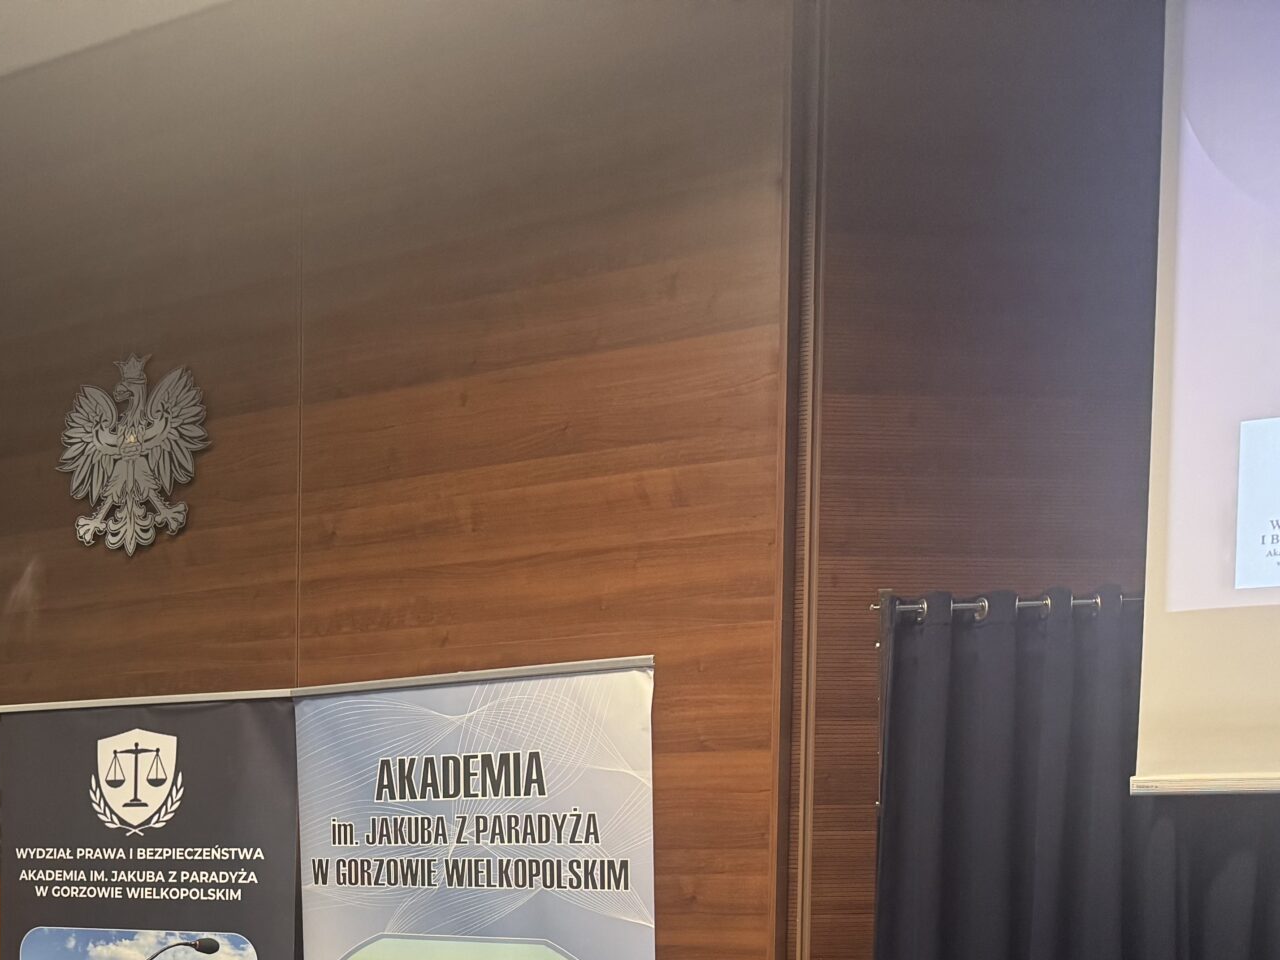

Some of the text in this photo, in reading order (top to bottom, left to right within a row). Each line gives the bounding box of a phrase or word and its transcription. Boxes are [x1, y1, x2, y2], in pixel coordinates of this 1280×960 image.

[375, 750, 547, 801] AKADEMIA
[331, 807, 601, 846] im. JAKUBA Z PARADYŻA
[15, 844, 265, 861] WYDZIAŁ PRAWA I BEZPIECZEŃSTWA
[19, 867, 259, 885] AKADEMIA IM. JAKUBA Z PARADYŻA
[311, 857, 631, 891] W GORZOWIE WIELKOPOLSKIM
[35, 886, 242, 901] W GORZOWIE WIELKOPOLSKIM
